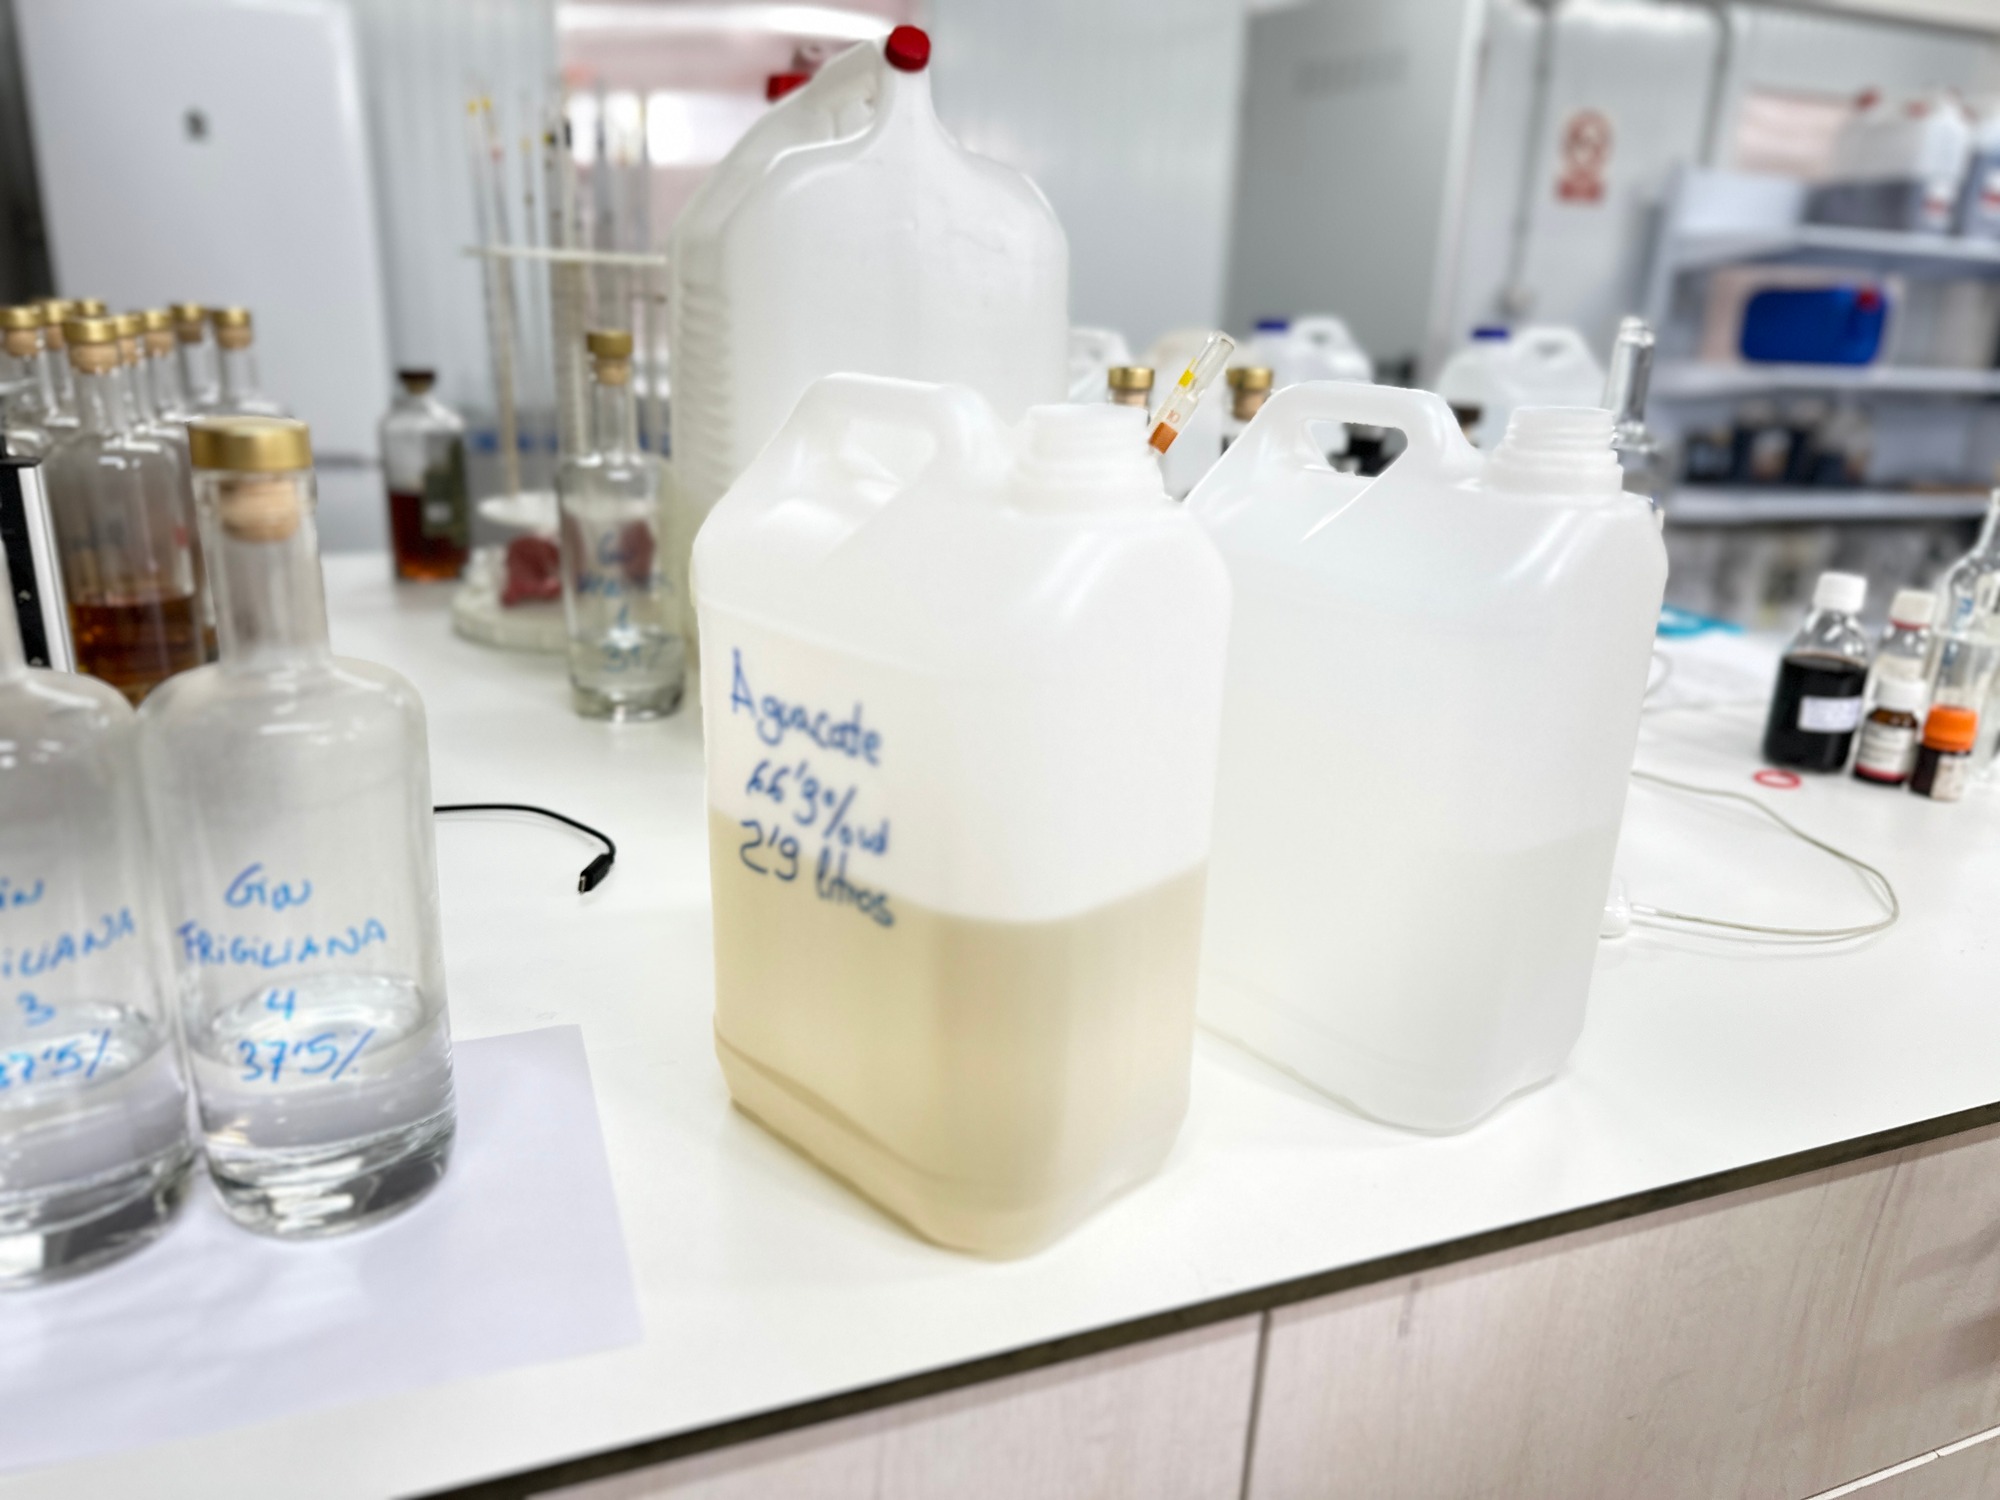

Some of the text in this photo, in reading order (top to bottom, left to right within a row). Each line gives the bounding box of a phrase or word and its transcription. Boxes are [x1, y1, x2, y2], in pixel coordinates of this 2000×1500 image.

[740, 819, 800, 882] 2'9
[16, 991, 57, 1026] 3
[265, 987, 296, 1021] 4
